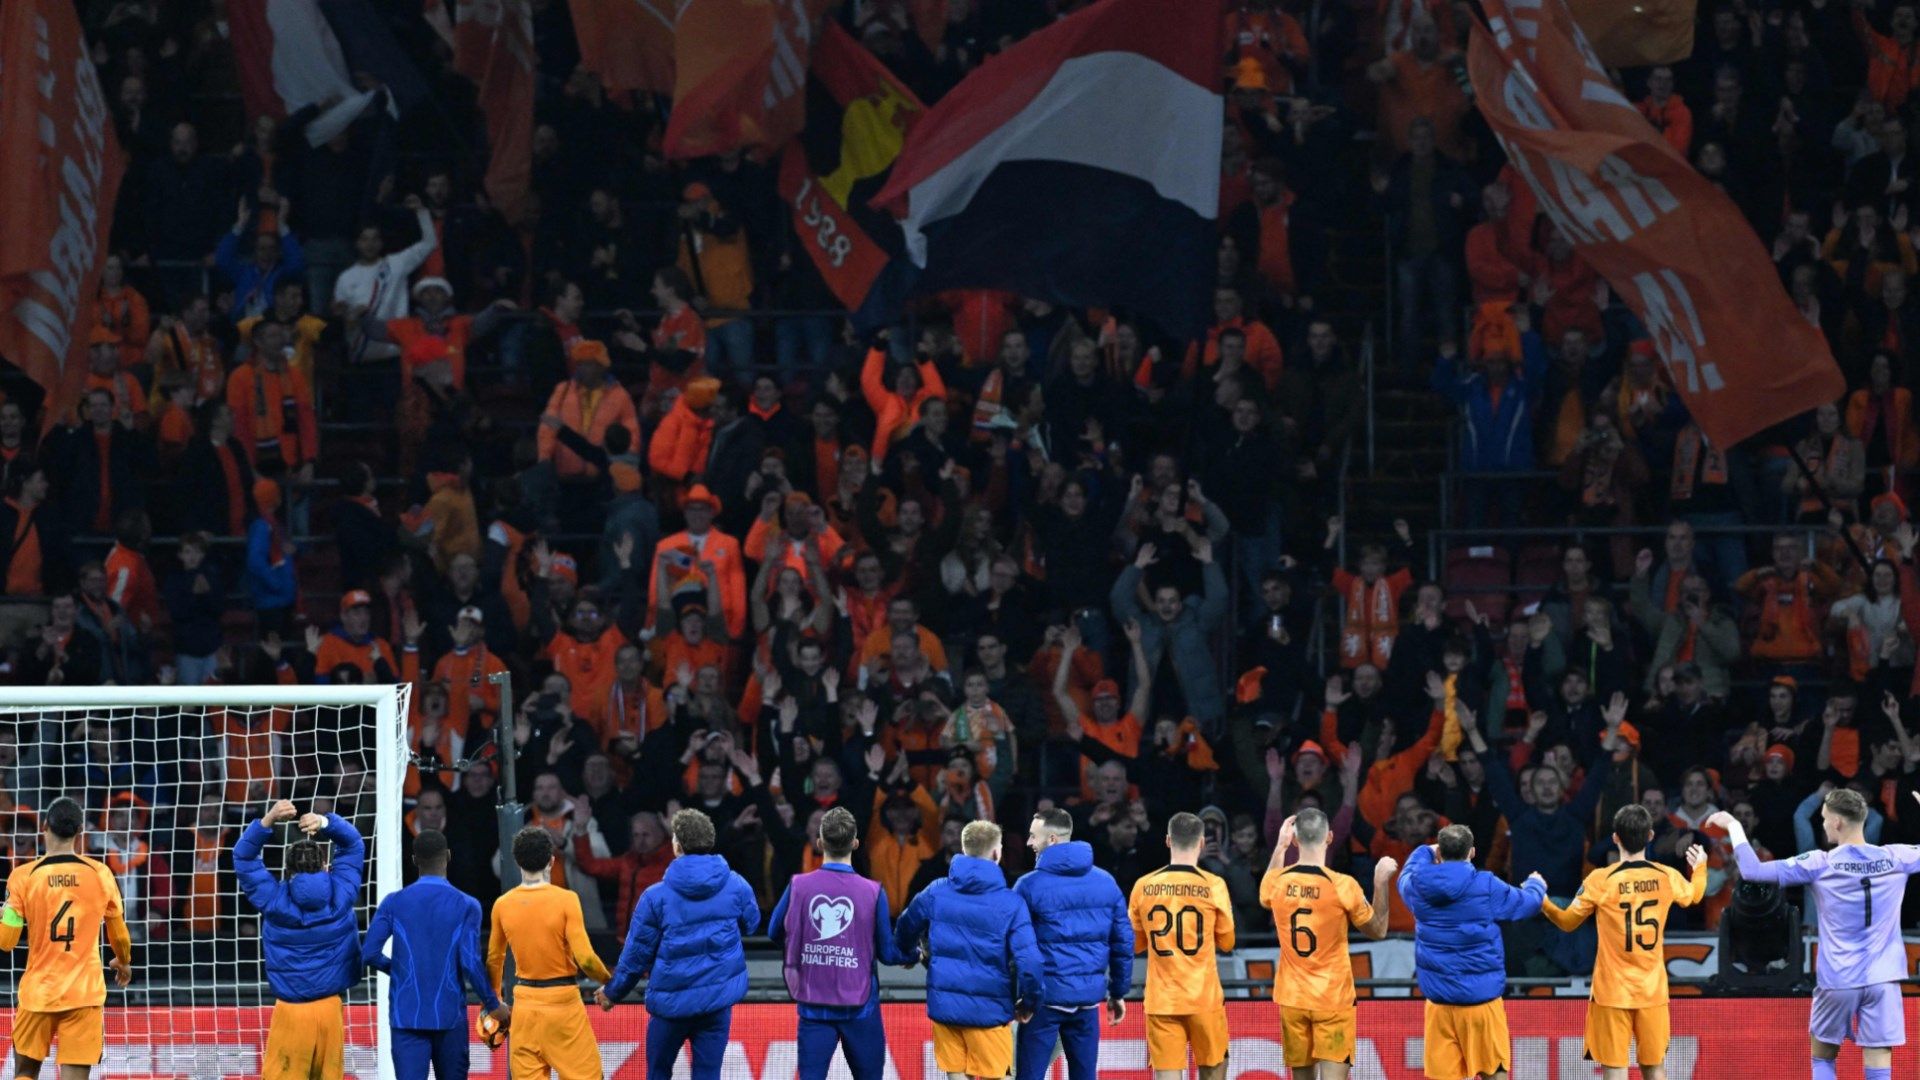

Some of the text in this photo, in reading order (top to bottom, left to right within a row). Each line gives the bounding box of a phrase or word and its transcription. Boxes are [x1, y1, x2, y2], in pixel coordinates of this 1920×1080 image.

[48, 874, 80, 888] VIRGIL
[1143, 883, 1211, 899] KOOPMEINERS
[1286, 884, 1321, 900] DE VRIJ
[1618, 879, 1660, 895] DE ROON
[1860, 876, 1872, 927] 1
[50, 900, 75, 952] 4
[1147, 904, 1204, 957] 20
[1290, 907, 1317, 957] 6
[1619, 899, 1660, 952] 15
[804, 943, 854, 957] EUROPEAN
